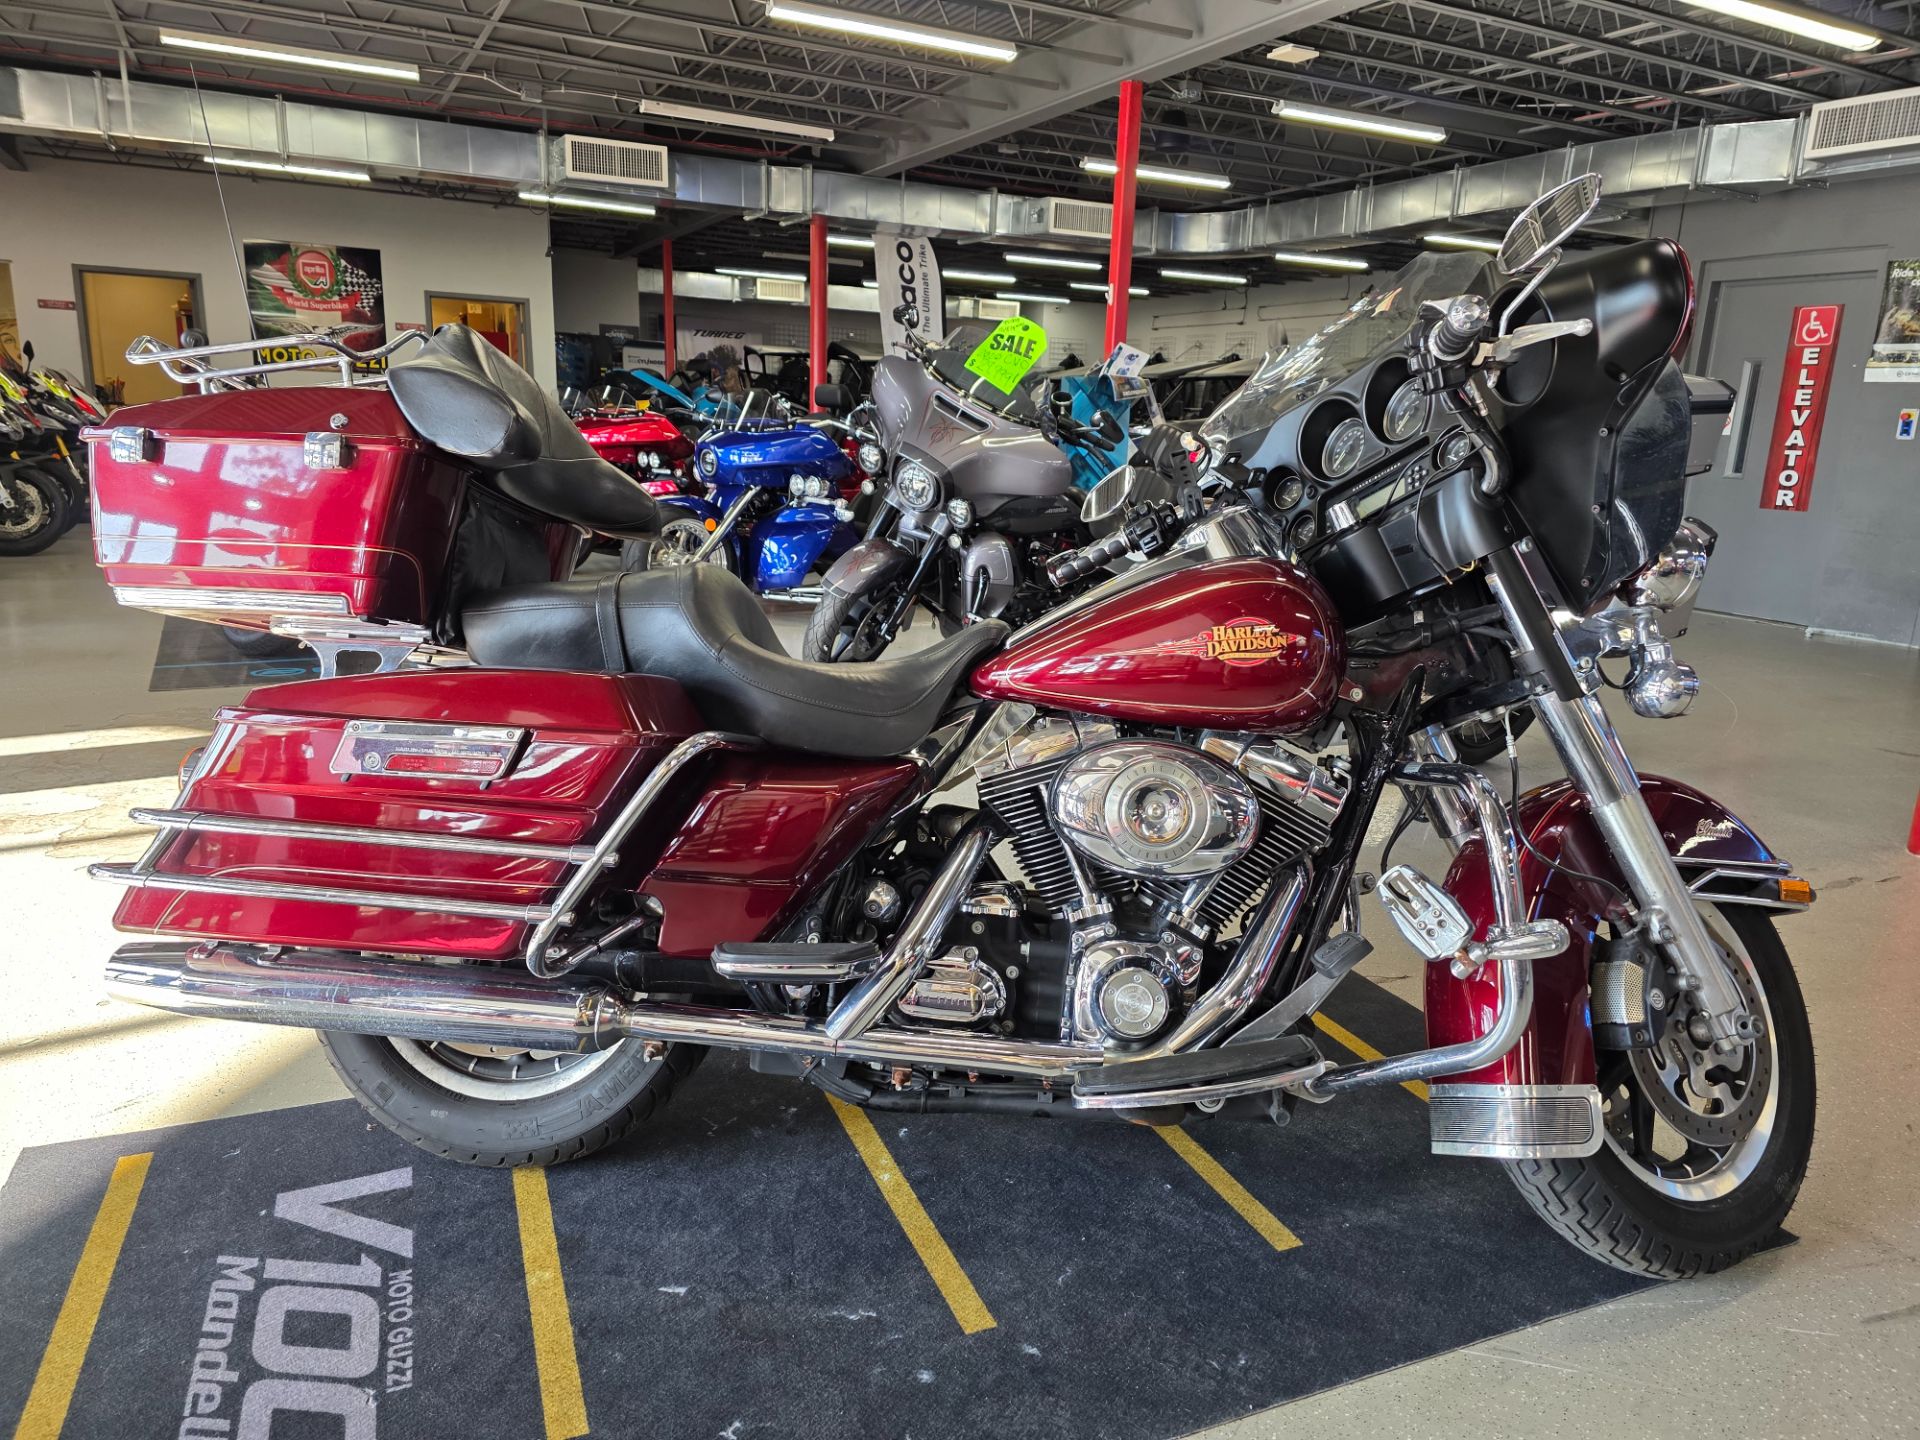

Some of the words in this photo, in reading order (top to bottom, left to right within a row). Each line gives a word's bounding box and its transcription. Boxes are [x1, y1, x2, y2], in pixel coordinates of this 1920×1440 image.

[919, 244, 928, 268] Trike
[1891, 268, 1914, 279] Ride
[286, 297, 309, 309] World
[310, 299, 349, 311] Superbikes
[921, 272, 930, 313] Ultimate
[922, 316, 931, 334] The
[260, 346, 317, 363] MOTO
[989, 333, 1037, 360] SALE
[1775, 347, 1820, 507] ELEVATOR
[1207, 635, 1287, 657] DAVIDSON
[388, 1269, 413, 1323] MOTO
[178, 1255, 259, 1440] Mandel
[386, 1327, 413, 1393] GUZZI
